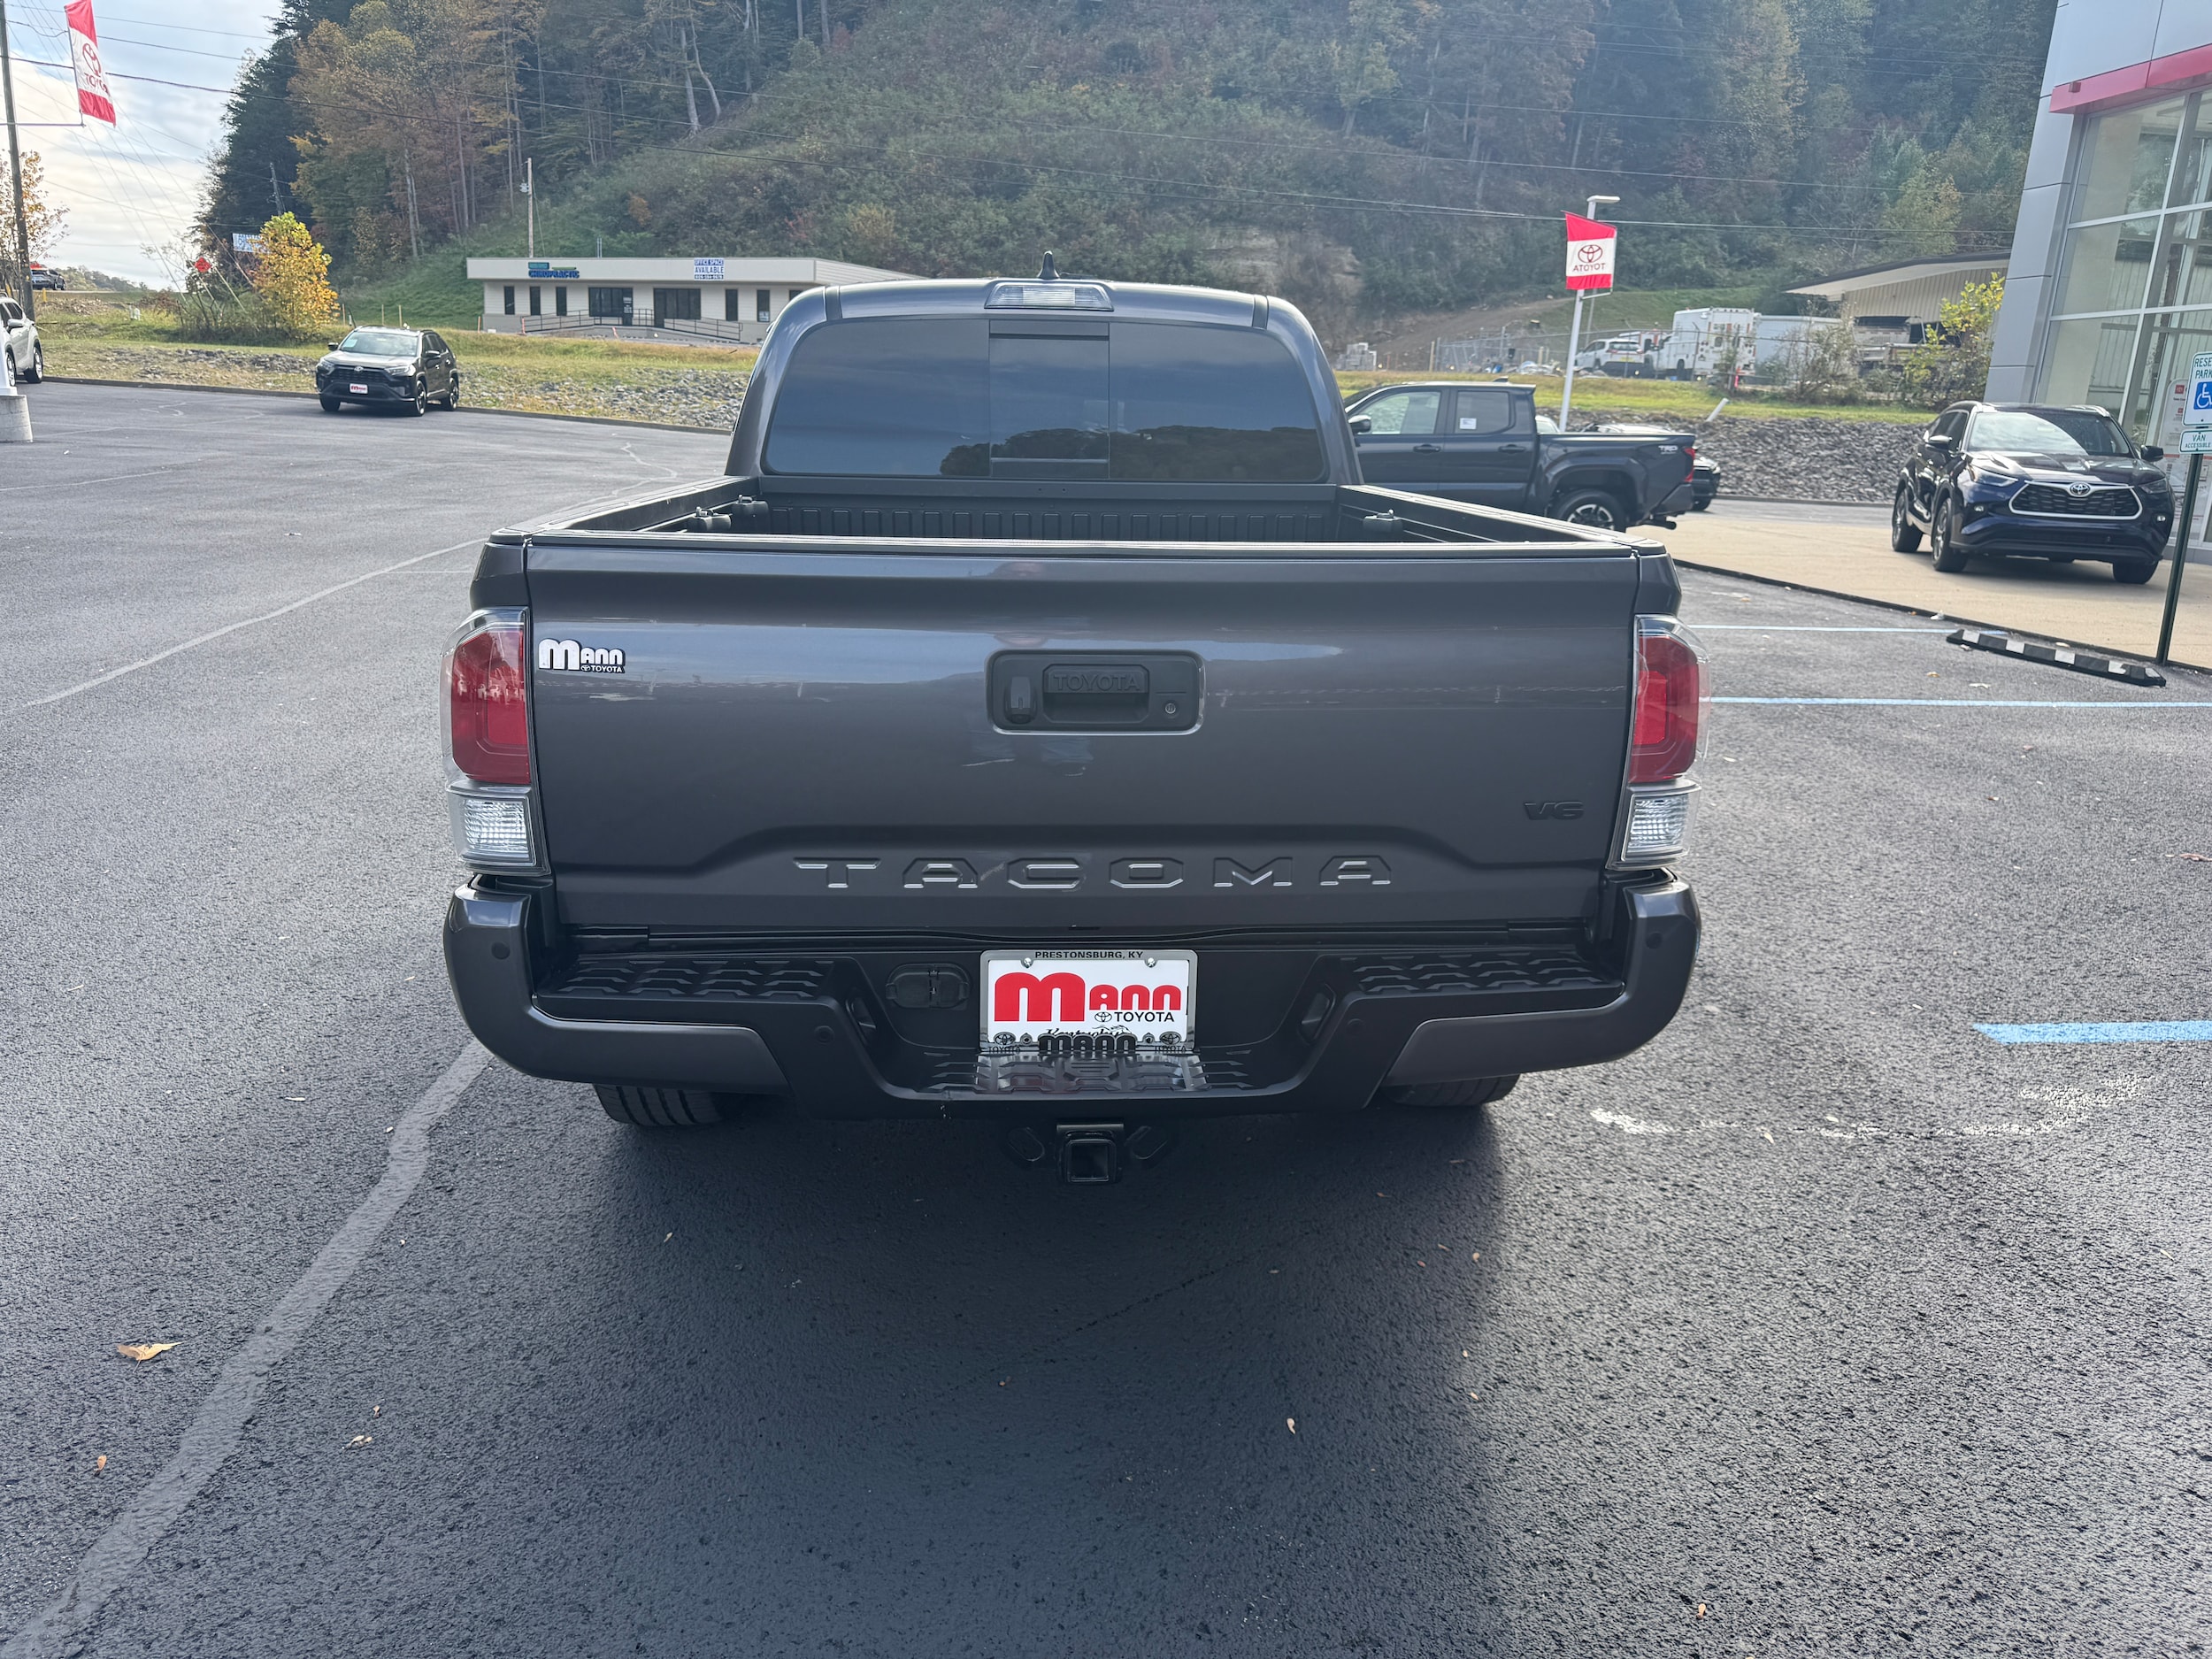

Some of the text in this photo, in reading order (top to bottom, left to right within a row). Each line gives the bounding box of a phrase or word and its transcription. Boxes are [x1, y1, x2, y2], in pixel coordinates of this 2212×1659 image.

[591, 664, 624, 673] TOYOTA
[1053, 674, 1141, 691] TOYOTA
[1524, 801, 1585, 820] V6
[794, 856, 1392, 888] TACOMA
[1114, 1011, 1174, 1022] TOYOTA
